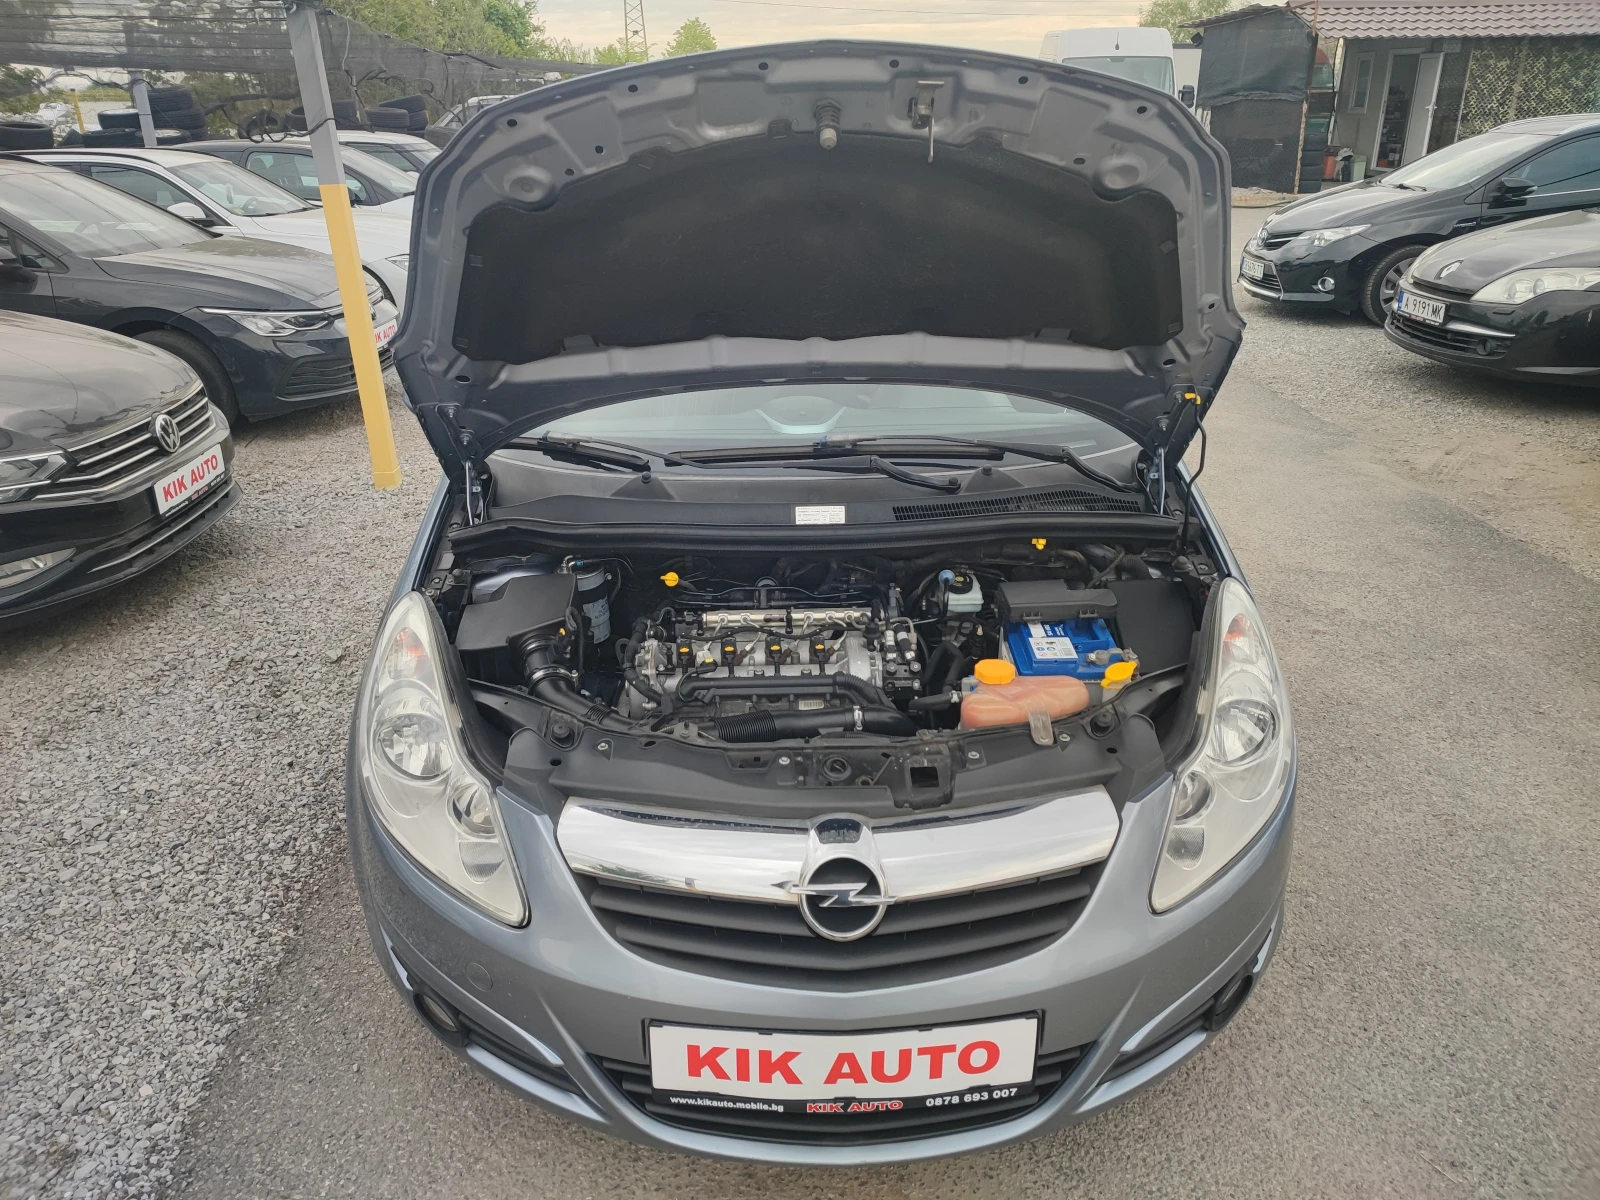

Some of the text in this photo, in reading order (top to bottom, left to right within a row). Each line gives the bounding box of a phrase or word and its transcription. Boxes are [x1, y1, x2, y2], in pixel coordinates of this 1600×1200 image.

[1412, 299, 1430, 316] 9191
[1431, 303, 1443, 320] MK
[162, 475, 187, 502] KIK
[190, 454, 218, 486] AUTO
[686, 1040, 1001, 1085] KIK AUTO
[669, 1096, 784, 1112] www.kikauto.mobile.bg
[806, 1100, 904, 1113] KIK AUTO
[925, 1087, 1018, 1107] 0878 693 007
